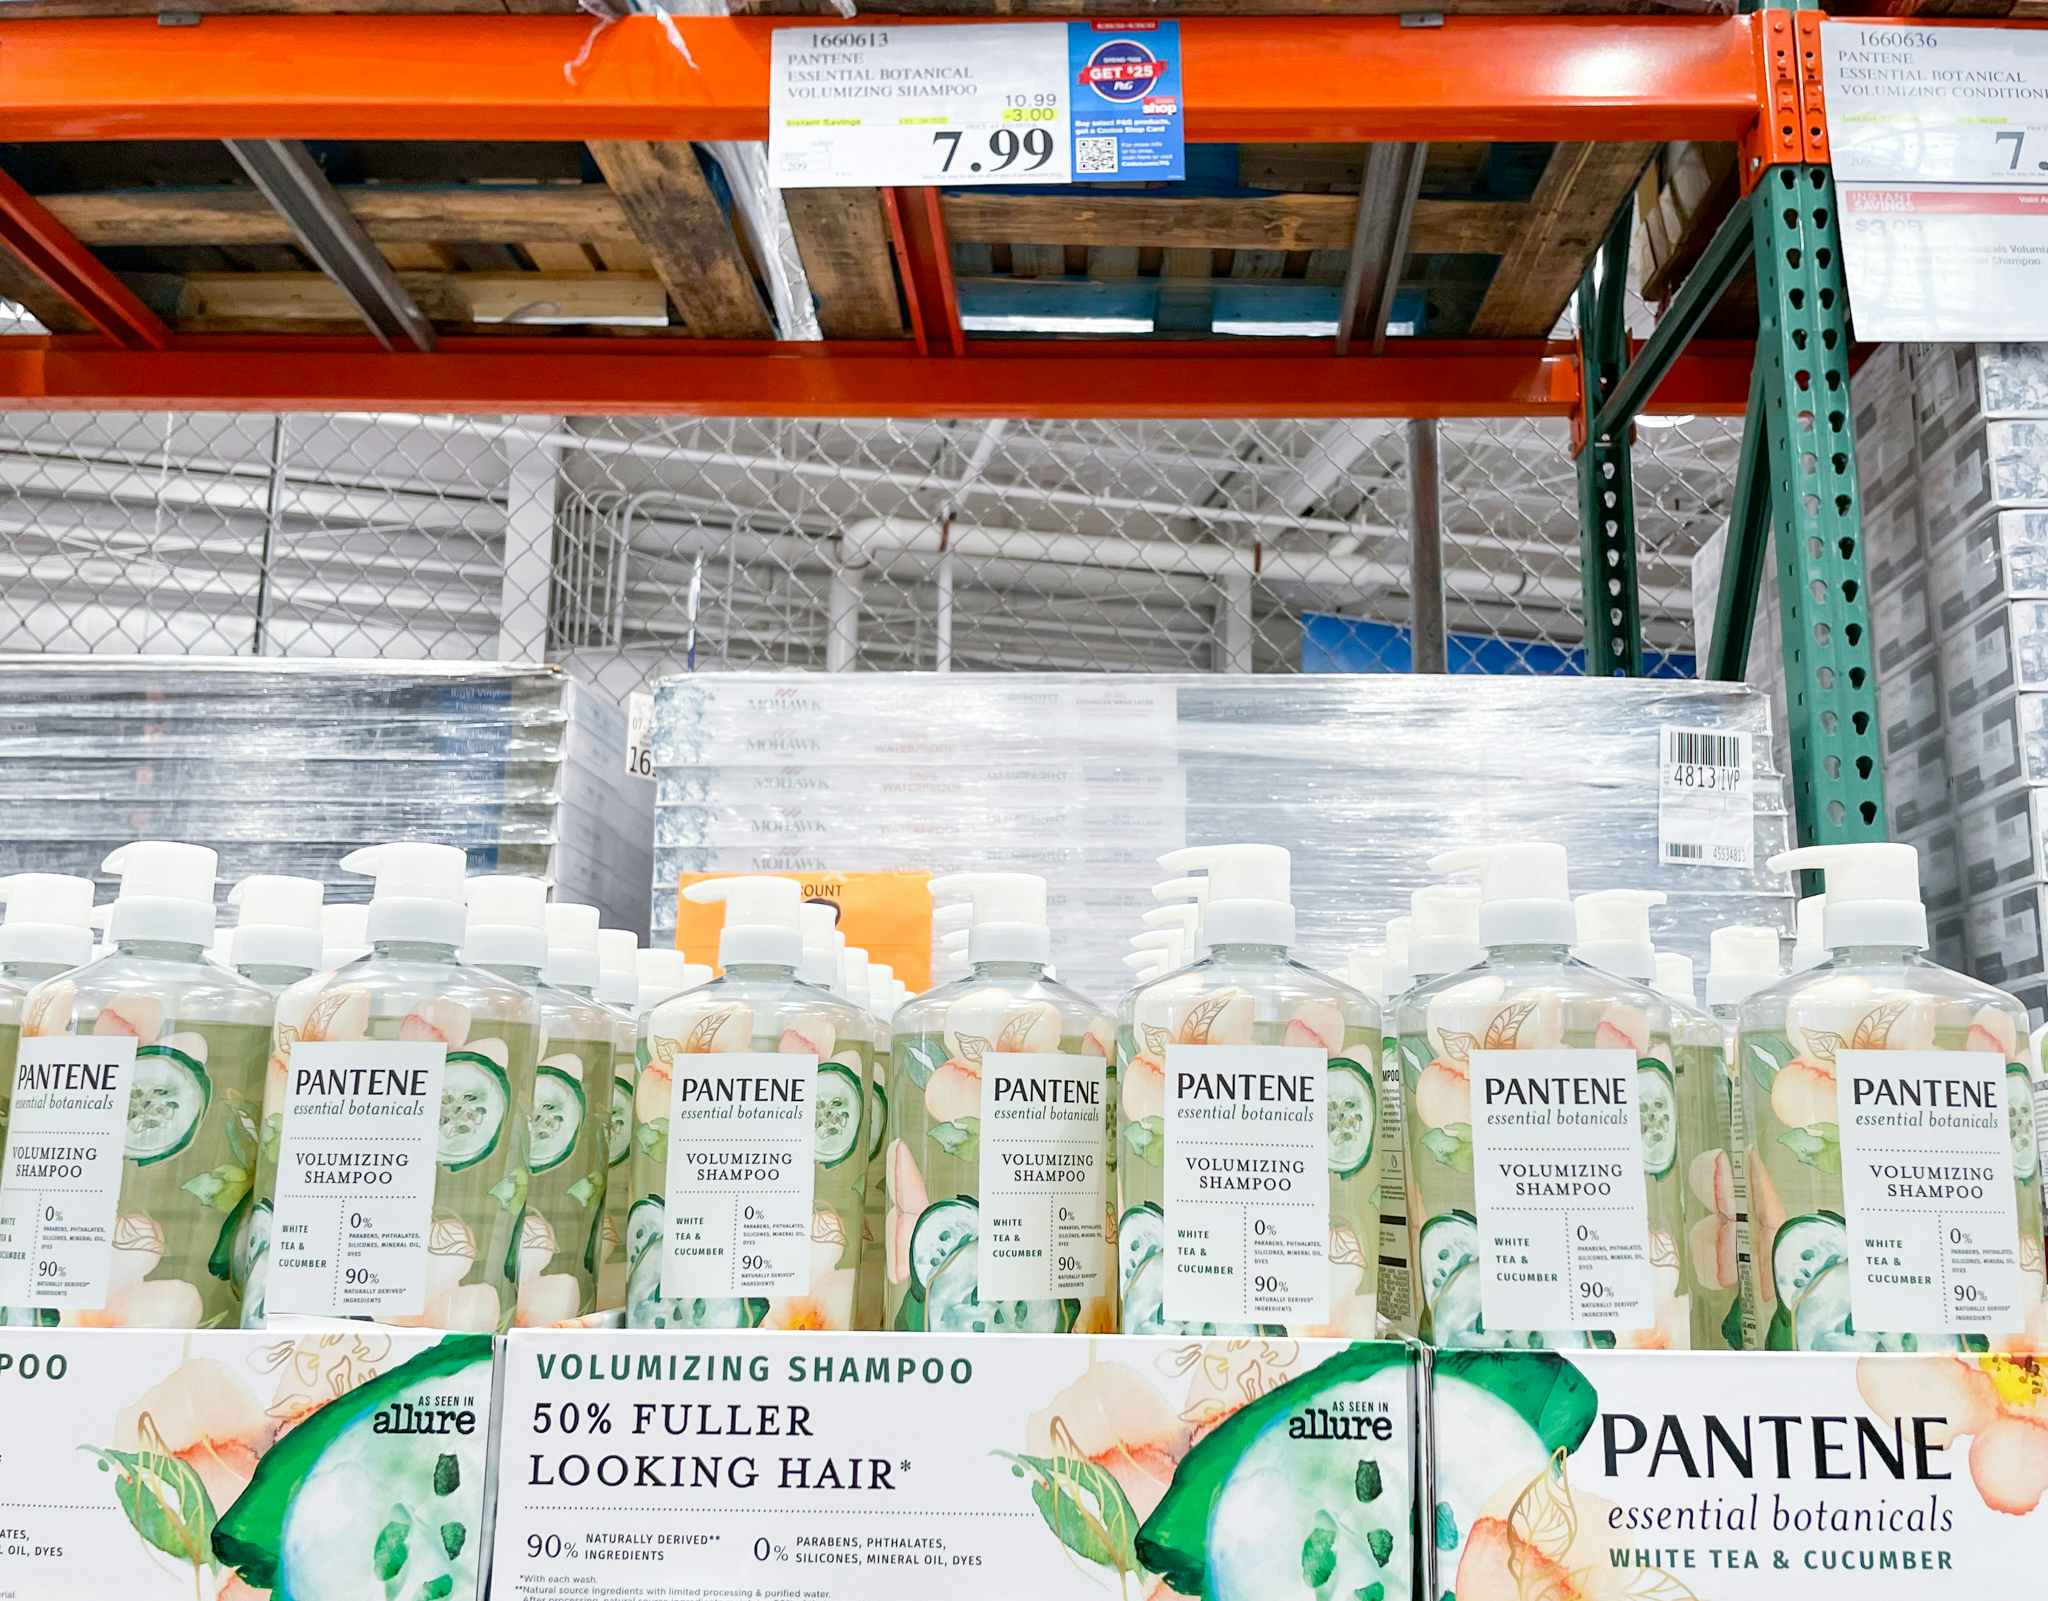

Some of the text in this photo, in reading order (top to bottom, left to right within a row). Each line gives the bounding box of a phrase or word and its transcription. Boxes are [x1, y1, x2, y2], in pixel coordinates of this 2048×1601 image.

[812, 32, 889, 49] 1660613
[1860, 31, 1938, 48] 1660636
[788, 52, 865, 65] PANTENE
[1838, 51, 1914, 64] PANTENE
[788, 67, 974, 82] ESSENTIAL BOTANICAL
[1090, 64, 1153, 80] GET $25
[1839, 67, 2028, 83] ESSENTIAL BOTANICAL
[787, 83, 979, 99] VOLUMIZING SHAMPOO
[1840, 84, 1947, 98] VOLUMIZING
[1006, 93, 1057, 107] 10.99
[1143, 101, 1177, 116] shop
[932, 127, 1054, 173] 7.99
[1852, 191, 1914, 202] INSTANT
[745, 737, 821, 751] MOHAWK
[629, 745, 656, 777] 16
[1674, 764, 1716, 789] 4813
[751, 819, 827, 833] MOHAWK
[751, 857, 828, 871] MOHAWK
[800, 884, 844, 897] OUNT
[17, 1063, 120, 1090] PANTENE
[295, 1069, 429, 1096] PANTENE
[681, 1078, 805, 1102] PANTENE
[994, 1077, 1100, 1104] PANTENE
[1177, 1072, 1314, 1102] PANTENE
[1485, 1078, 1628, 1104] PANTENE
[1853, 1078, 1998, 1108] PANTENE
[50, 1094, 114, 1110] botanicals
[293, 1099, 425, 1116] essential botanicals
[681, 1104, 803, 1119] essential botanicals
[994, 1105, 1099, 1122] essential botanicals
[1177, 1104, 1314, 1122] essential botanicals
[1487, 1108, 1628, 1125] essential botanicals
[1855, 1110, 1999, 1129] essential botanicals
[12, 1146, 98, 1161] VOLUMIZING
[296, 1153, 409, 1167] VOLUMIZING
[686, 1153, 793, 1165] VOLUMIZING
[1001, 1153, 1094, 1167] VOLUMIZING
[15, 1164, 82, 1178] SHAMPOO
[1185, 1157, 1305, 1174] VOLUMIZING
[1499, 1164, 1622, 1178] VOLUMIZING
[1869, 1164, 1995, 1181] VOLUMIZING
[304, 1170, 393, 1184] SHAMPOO
[697, 1168, 780, 1181] SHAMPOO
[1014, 1169, 1086, 1182] SHAMPOO
[1199, 1175, 1292, 1191] SHAMPOO
[1515, 1182, 1611, 1196] SHAMPOO
[1887, 1183, 1984, 1199] SHAMPOO
[282, 1224, 309, 1233] WHITE
[676, 1217, 704, 1225] WHITE
[675, 1232, 702, 1240] TEA &
[1177, 1229, 1209, 1239] WHITE
[280, 1241, 305, 1250] TEA &
[1494, 1237, 1530, 1247] WHITE
[1865, 1239, 1903, 1249] WHITE
[674, 1247, 724, 1256] CUCUMBER
[1177, 1246, 1208, 1256] TEA &
[278, 1258, 327, 1268] CUCUMBER
[1496, 1255, 1529, 1264] TEA &
[1866, 1256, 1902, 1266] TEA &
[1177, 1263, 1234, 1275] CUCUMBER
[1496, 1272, 1559, 1282] CUCUMBER
[1867, 1273, 1932, 1284] CUCUMBER
[536, 1352, 974, 1384] VOLUMIZING SHAMPOO
[418, 1395, 474, 1407] AS SEEN IN
[1332, 1401, 1389, 1413] AS SEEN IN
[372, 1402, 477, 1435] allure
[532, 1401, 814, 1437] 50% FULLER
[1288, 1407, 1393, 1441] allure
[1600, 1413, 1953, 1481] PANTENE
[528, 1453, 760, 1489] LOOKING
[1607, 1493, 1953, 1532] essential botanicals
[586, 1533, 652, 1544] NATURALLY
[796, 1536, 946, 1551] PARABENS, PHTHALATES,
[8, 1545, 63, 1558] OIL, DYES
[527, 1533, 579, 1560] 90%
[753, 1536, 789, 1562] 0%
[584, 1550, 664, 1561] INGREDIENTS
[795, 1552, 983, 1567] SILICONES, MINERAL OIL, DYES
[1608, 1547, 1953, 1571] WHITE TEA & CUCUMBER
[548, 1574, 570, 1584] each
[558, 1586, 590, 1596] source
[592, 1586, 644, 1597] ingredients
[646, 1586, 667, 1597] with
[668, 1587, 701, 1597] limited
[703, 1588, 753, 1600] processing
[764, 1588, 801, 1600] purified
